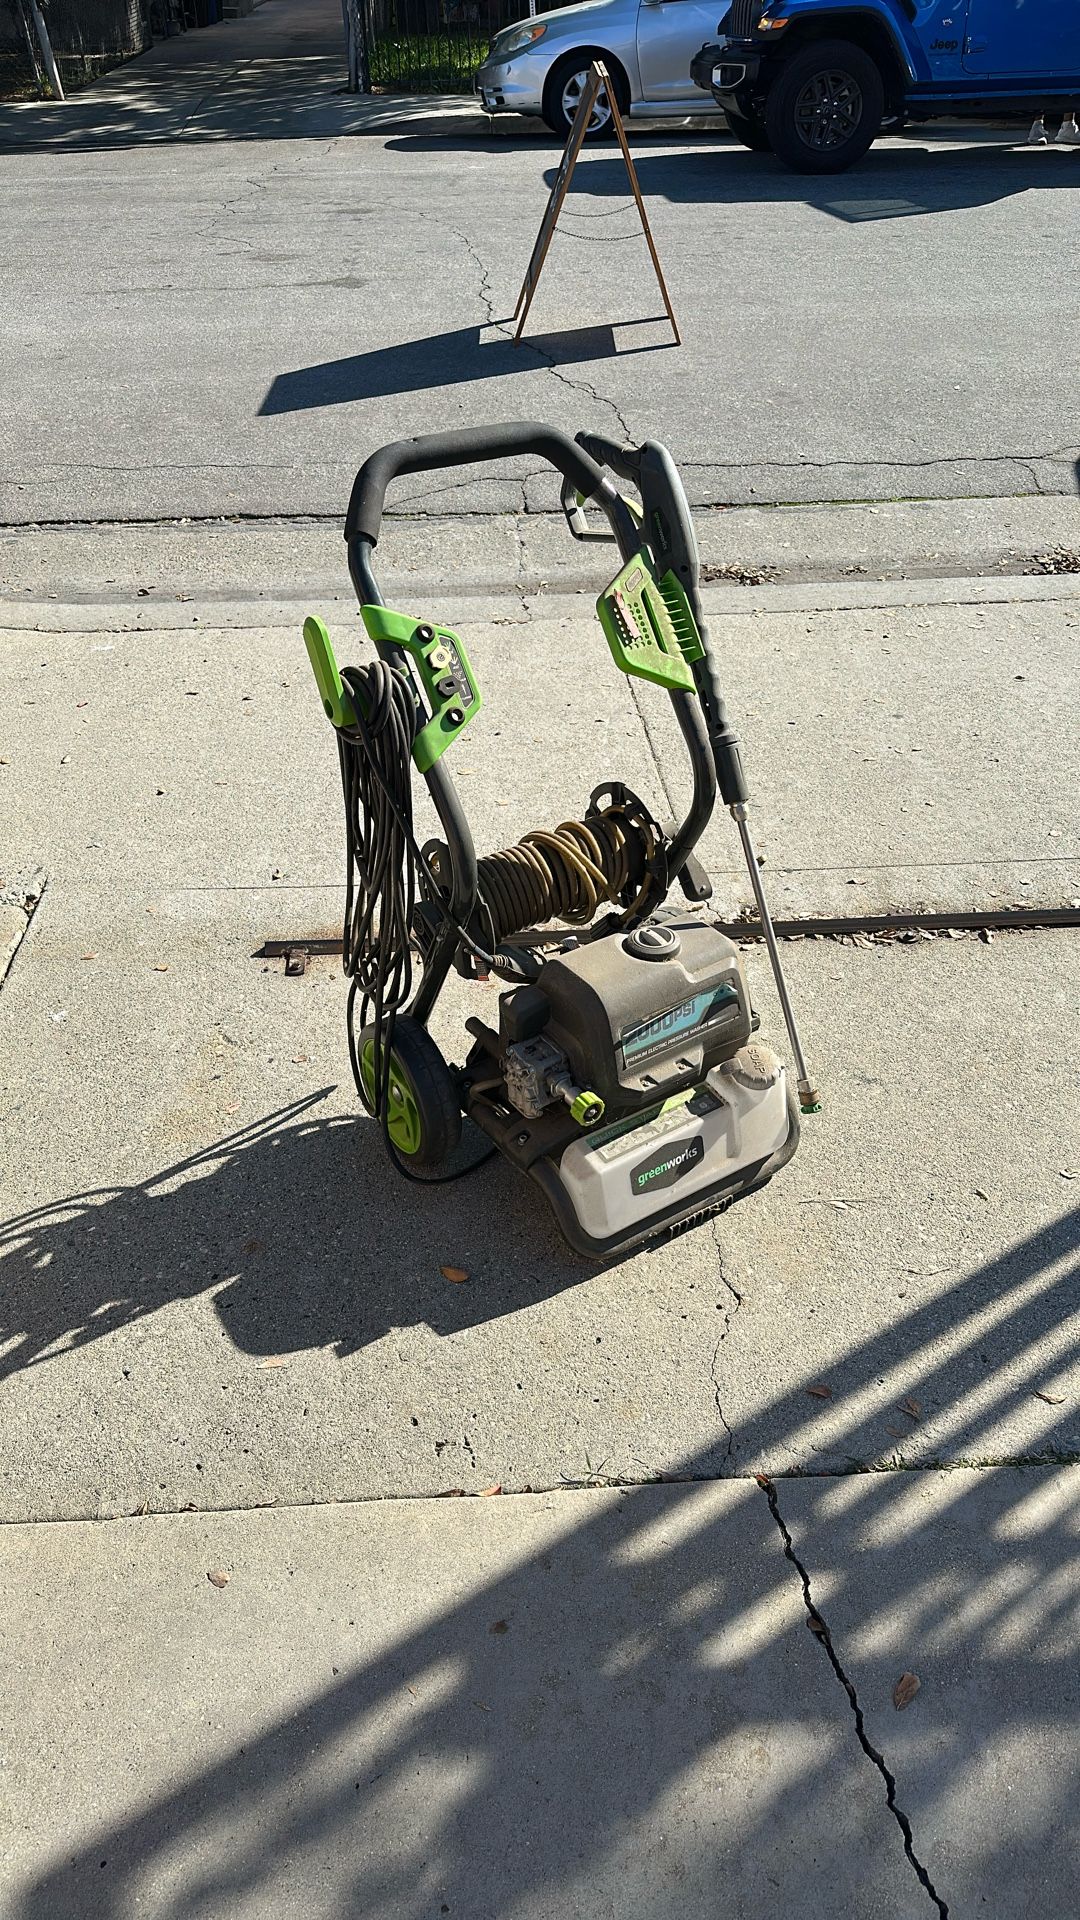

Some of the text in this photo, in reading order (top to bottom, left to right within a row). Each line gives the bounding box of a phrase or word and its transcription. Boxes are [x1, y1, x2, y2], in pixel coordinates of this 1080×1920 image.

[930, 38, 958, 51] Jeep
[626, 1022, 709, 1063] PREMIUM ELECTRIC PRESSURE WASHER
[747, 1049, 766, 1074] SOAP
[638, 1147, 698, 1187] greenworks
